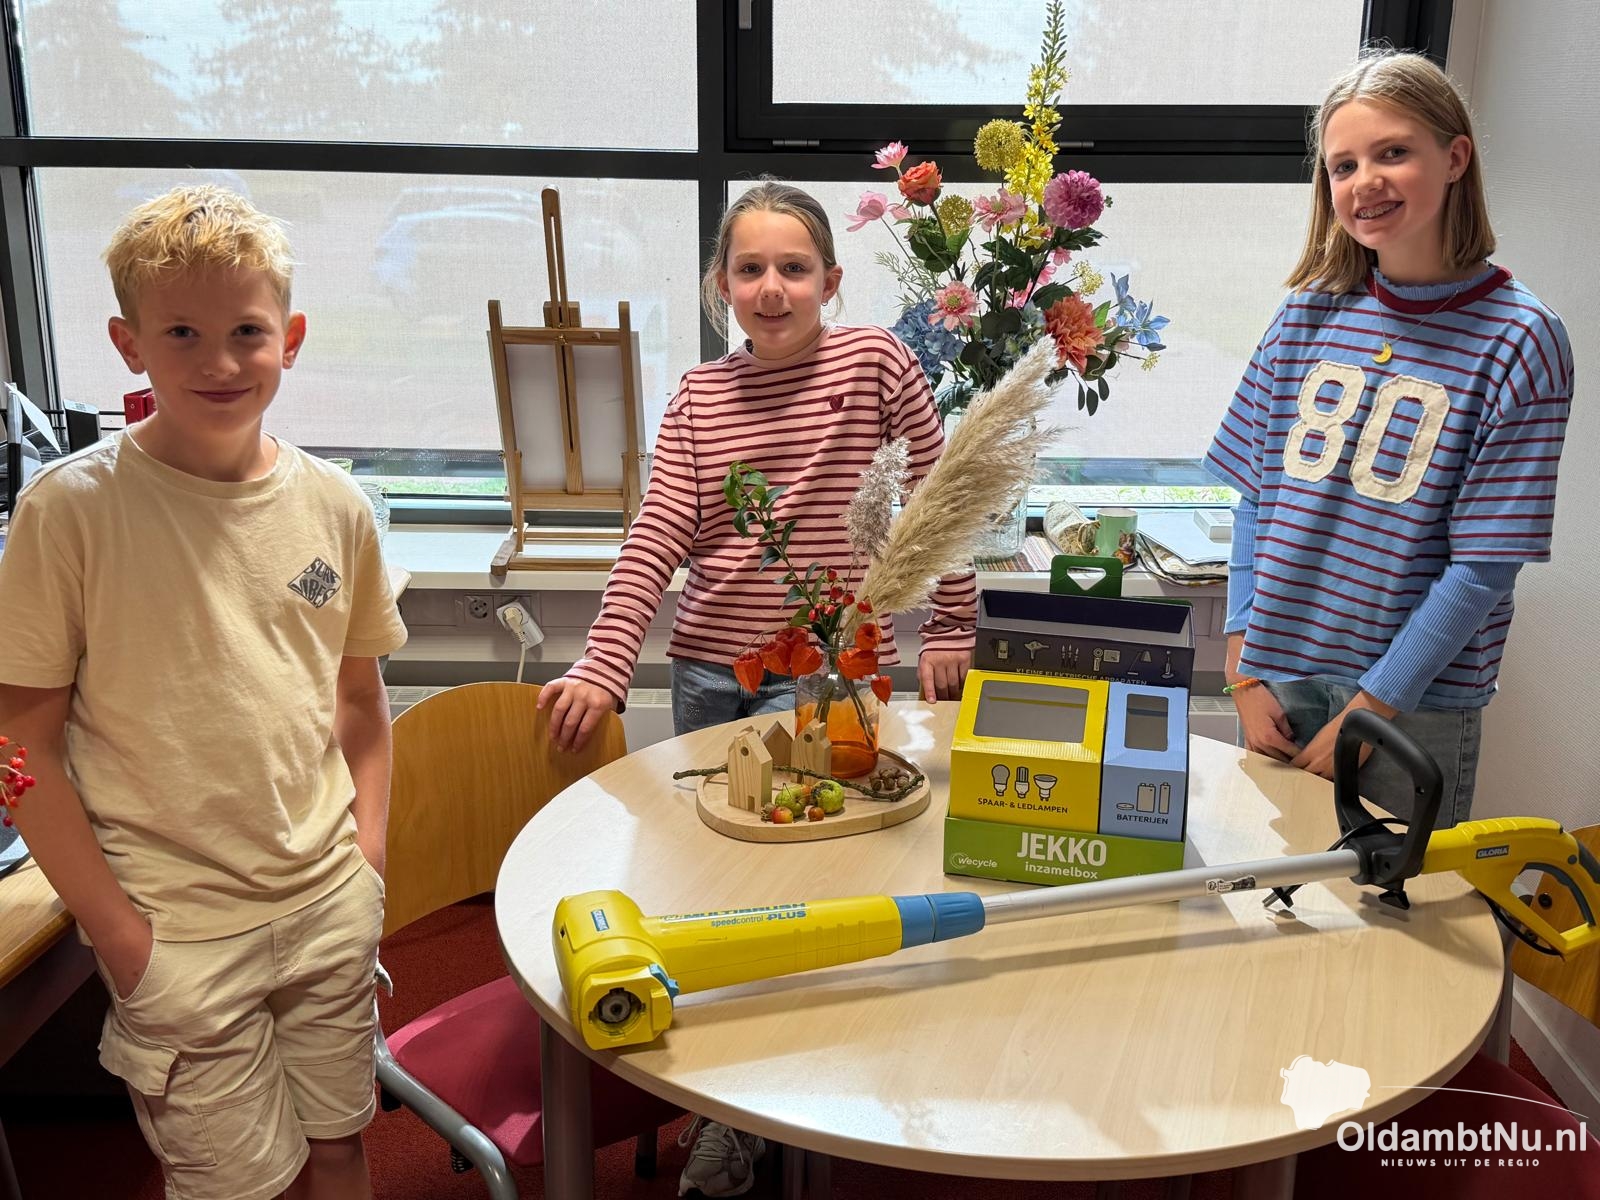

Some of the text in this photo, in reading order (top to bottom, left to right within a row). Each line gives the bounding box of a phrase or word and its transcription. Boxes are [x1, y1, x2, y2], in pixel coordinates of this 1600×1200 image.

[1283, 360, 1450, 503] 80
[303, 560, 340, 583] SURF
[288, 579, 336, 607] VIBES
[977, 797, 1008, 807] SPAAR-
[1017, 802, 1068, 814] LEDLAMPEN
[1116, 813, 1169, 825] BATTERIJEN
[1016, 832, 1107, 867] JEKKO
[1477, 847, 1509, 858] GLORIA
[1025, 861, 1098, 880] inzamelbox
[711, 910, 807, 928] speedcontrol PLUS
